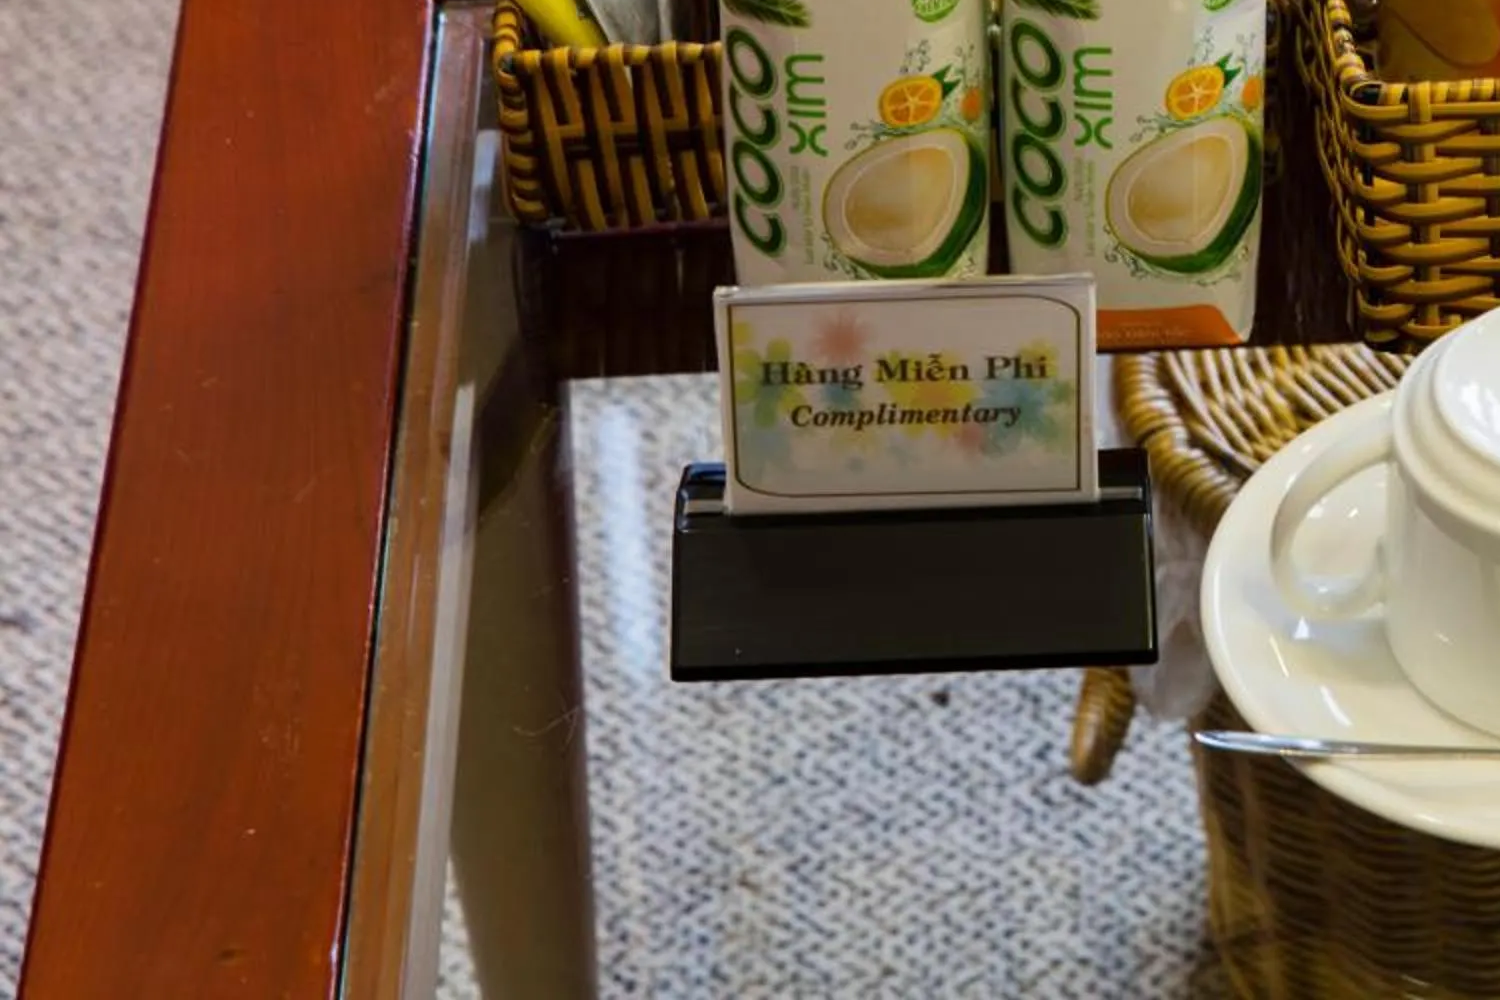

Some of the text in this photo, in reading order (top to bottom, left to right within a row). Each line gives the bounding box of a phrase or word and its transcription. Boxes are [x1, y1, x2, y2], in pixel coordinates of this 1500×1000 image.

[760, 359, 864, 390] Hàng
[875, 353, 971, 382] Miễn
[790, 401, 1022, 432] Complimentary
